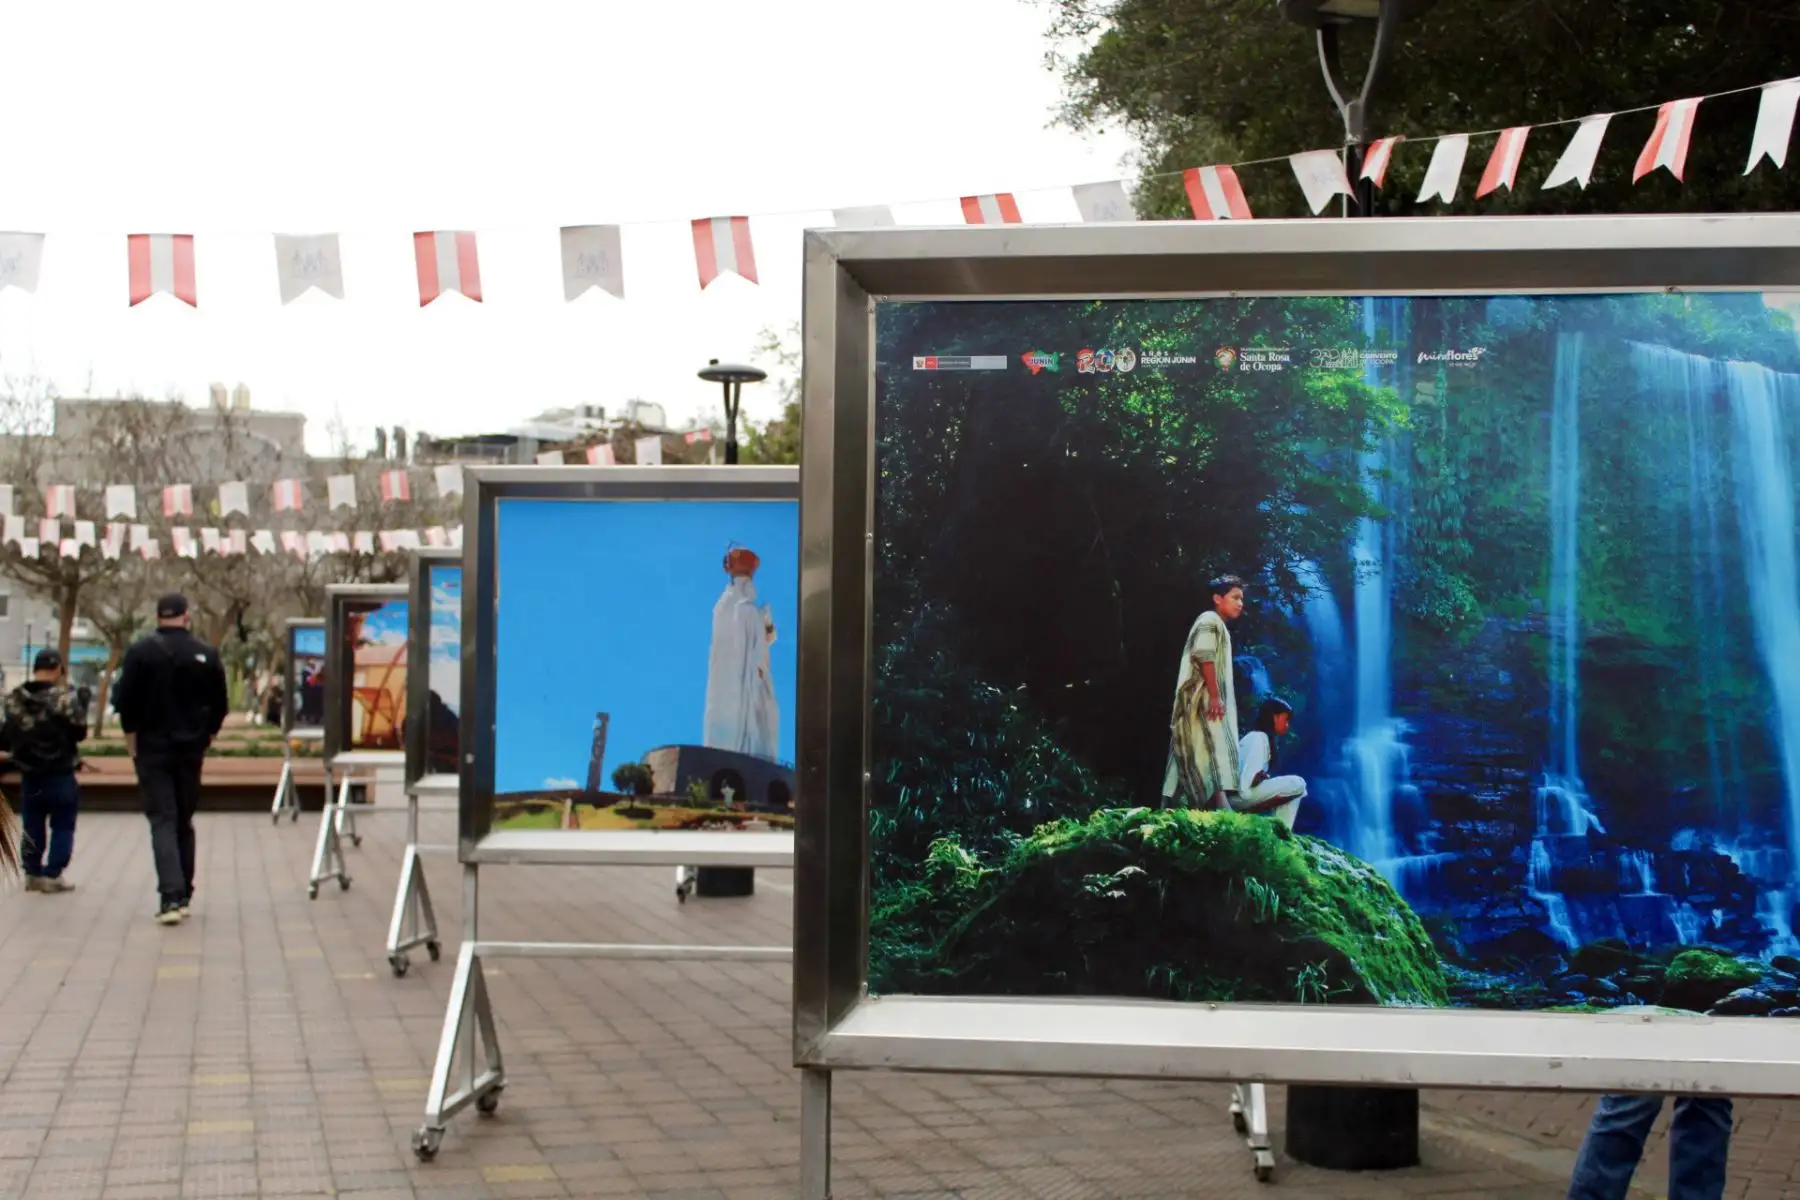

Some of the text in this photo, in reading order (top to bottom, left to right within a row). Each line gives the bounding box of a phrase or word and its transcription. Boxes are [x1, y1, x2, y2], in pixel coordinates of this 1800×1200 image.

[1240, 352, 1290, 362] Santa Rosa
[1240, 362, 1282, 372] de Ocopa
